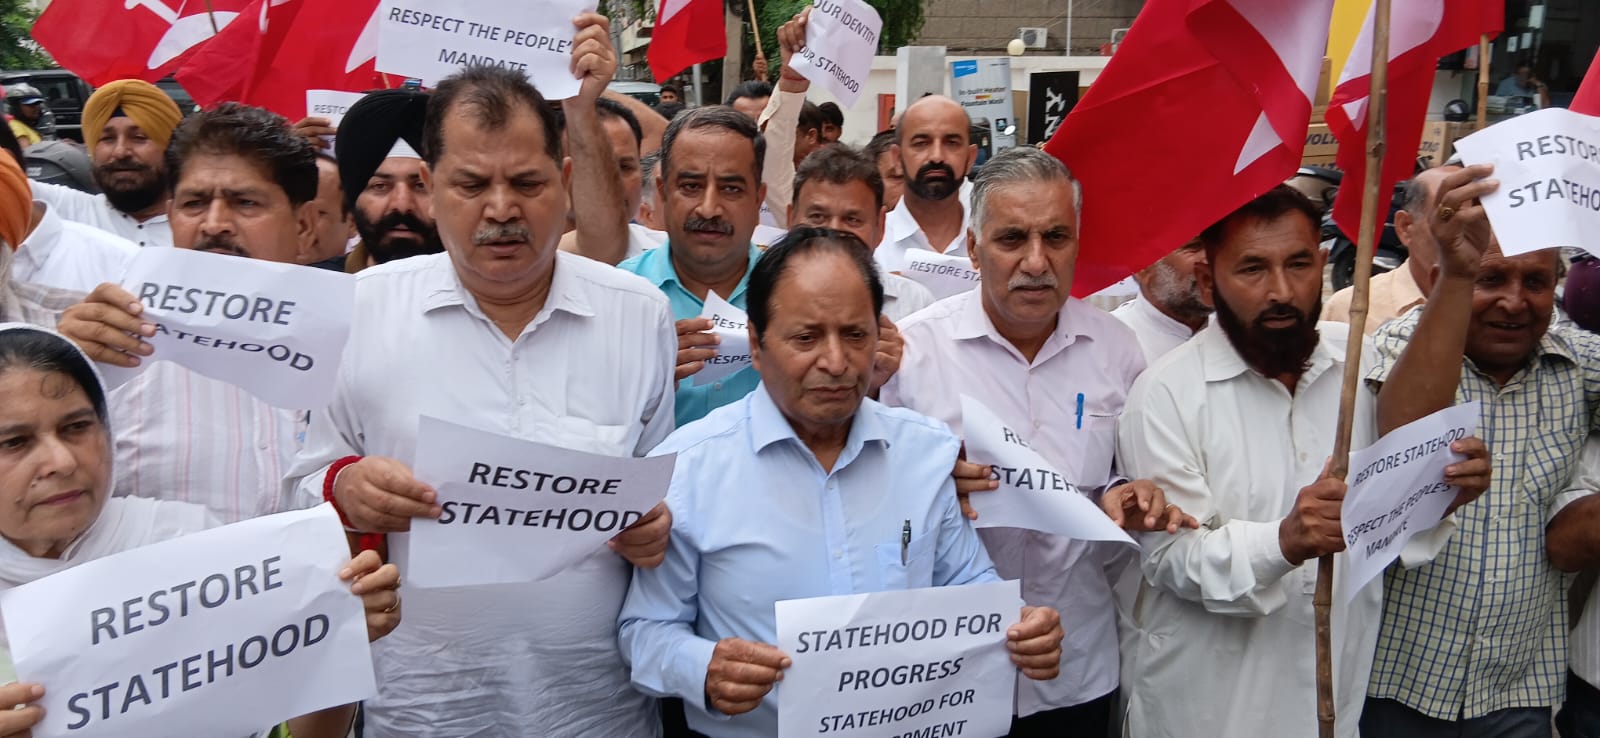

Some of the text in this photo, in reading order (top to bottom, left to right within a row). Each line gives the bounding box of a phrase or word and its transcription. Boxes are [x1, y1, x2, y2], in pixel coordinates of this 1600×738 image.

[389, 7, 574, 55] RESPECT THE PEOPLE'
[840, 11, 876, 46] IDENTITY
[815, 56, 860, 93] STATEHOOD
[1305, 133, 1339, 145] VOLT
[1516, 134, 1600, 165] RESTOR
[909, 261, 962, 277] RESTORE
[139, 282, 296, 326] RESTORE
[712, 314, 750, 329] REST
[154, 323, 314, 371] ATEHOOD
[468, 462, 622, 495] RESTORE
[1353, 452, 1402, 488] RESTORE
[438, 501, 643, 532] STATEHOOD
[90, 555, 283, 646] RESTORE
[796, 612, 1003, 654] STATEHOOD FOR
[67, 613, 330, 731] STATEHOOD
[838, 656, 964, 693] PROGRESS
[818, 688, 976, 734] STATEHOOD FOR
